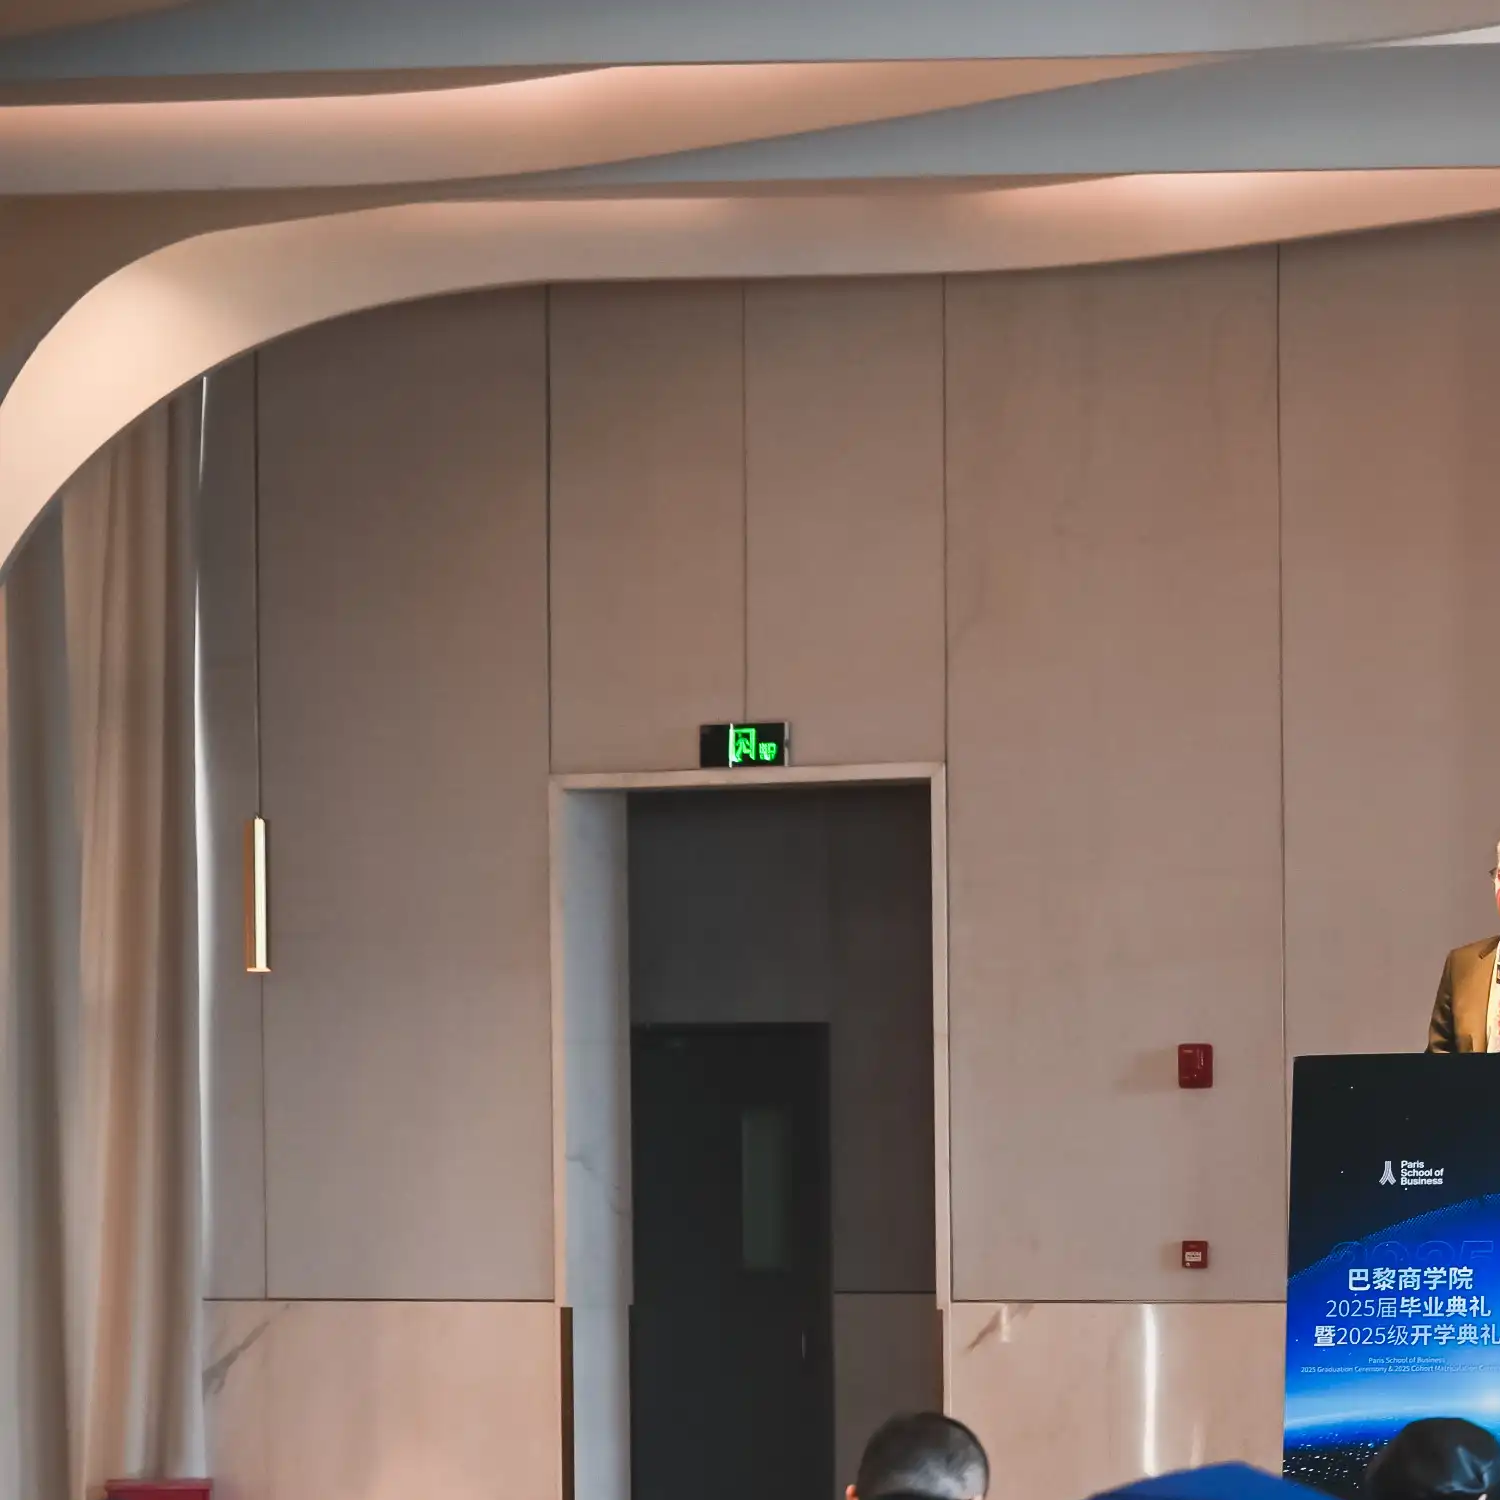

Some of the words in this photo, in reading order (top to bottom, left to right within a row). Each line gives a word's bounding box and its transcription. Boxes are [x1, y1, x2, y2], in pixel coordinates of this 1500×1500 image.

[1400, 1160, 1425, 1169] Paris
[1400, 1168, 1433, 1177] School
[1434, 1168, 1444, 1176] of
[1400, 1177, 1443, 1185] Business
[1348, 1266, 1474, 1291] 巴黎商学院
[1325, 1296, 1492, 1318] 2025届毕业典礼
